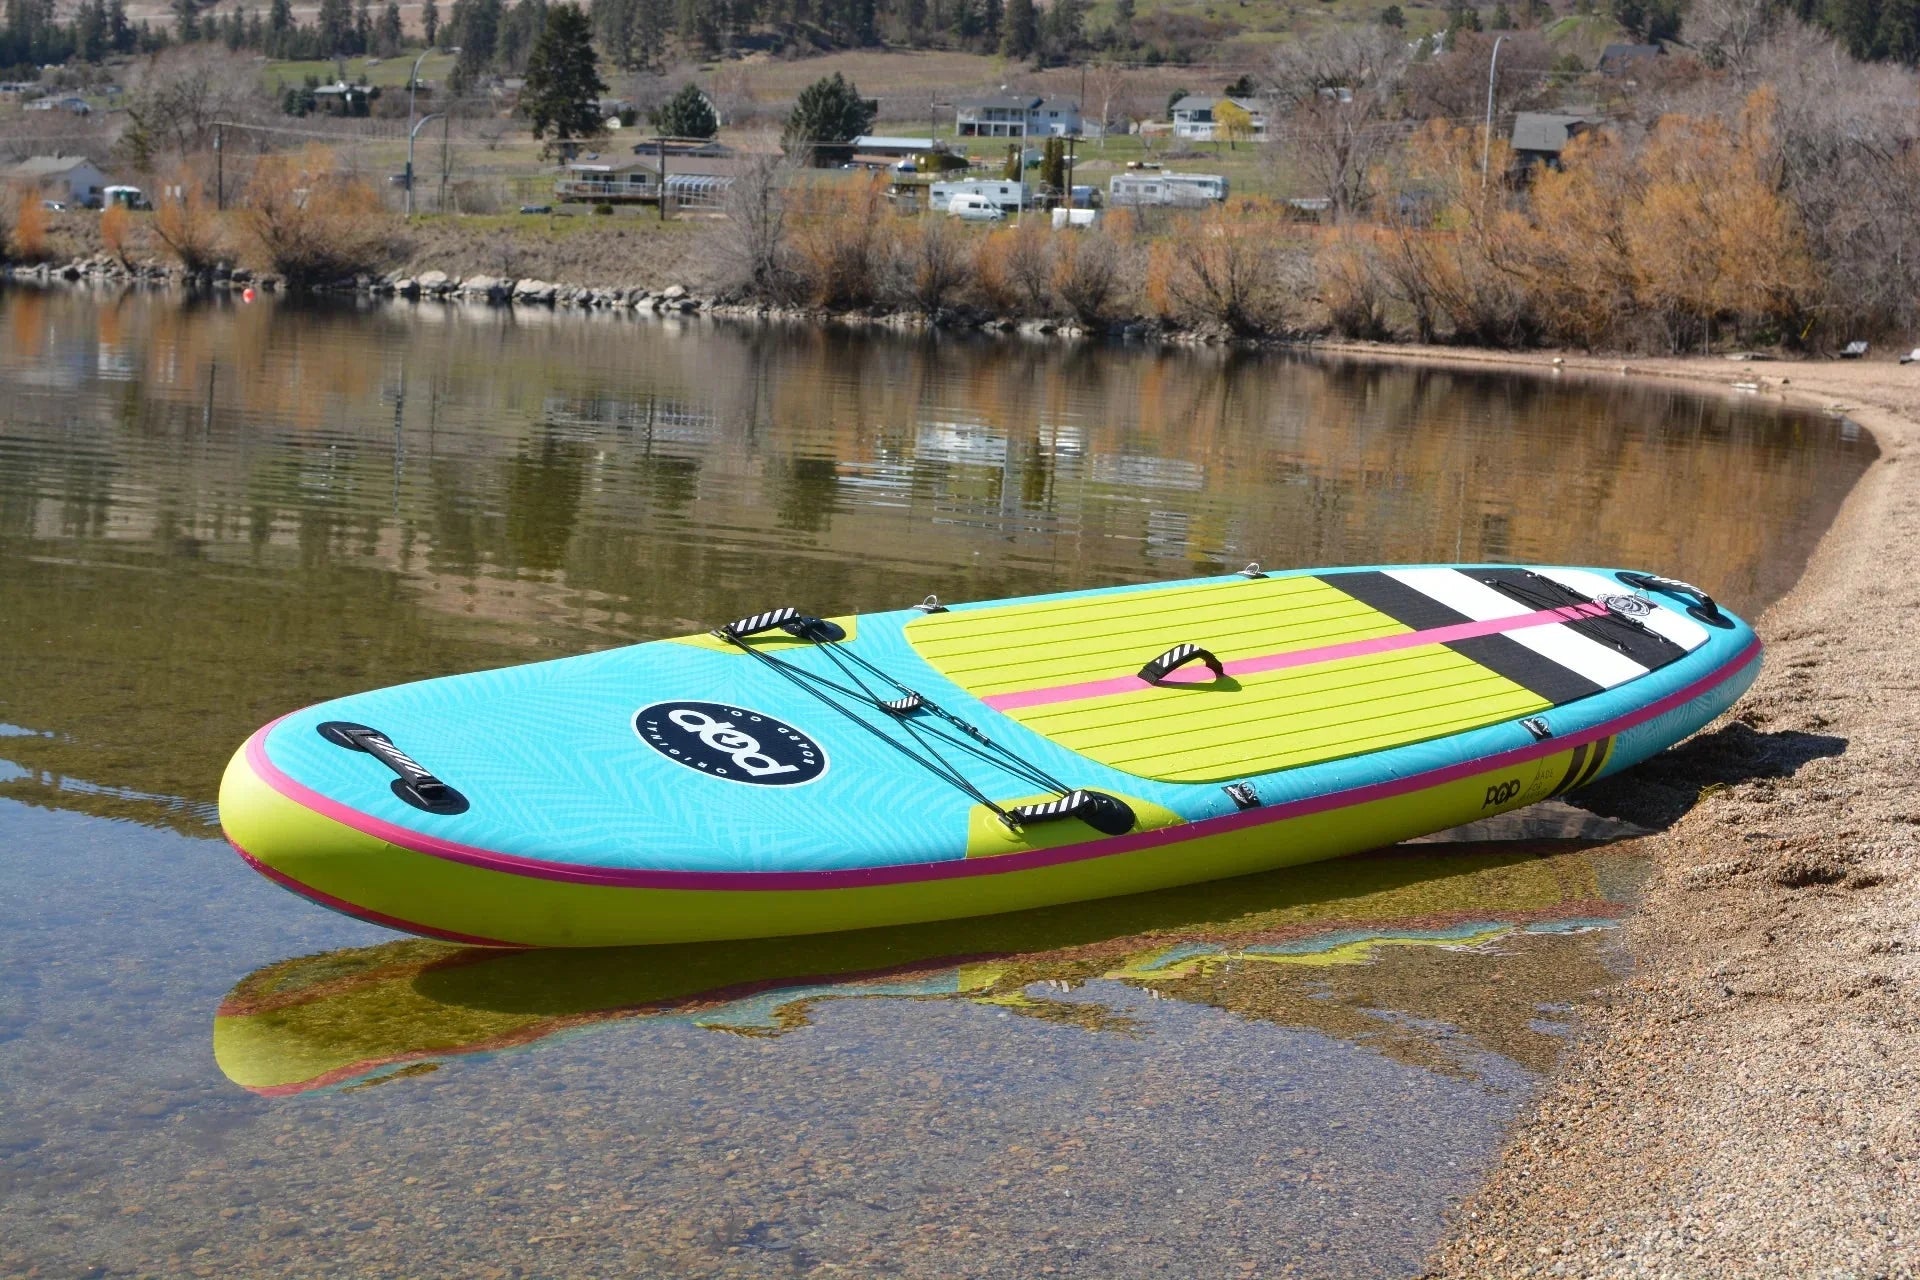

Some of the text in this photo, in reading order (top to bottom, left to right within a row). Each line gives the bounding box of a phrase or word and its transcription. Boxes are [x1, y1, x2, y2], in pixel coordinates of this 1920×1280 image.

[646, 720, 727, 774] ORIGINAL
[724, 708, 815, 765] BOARD CO.
